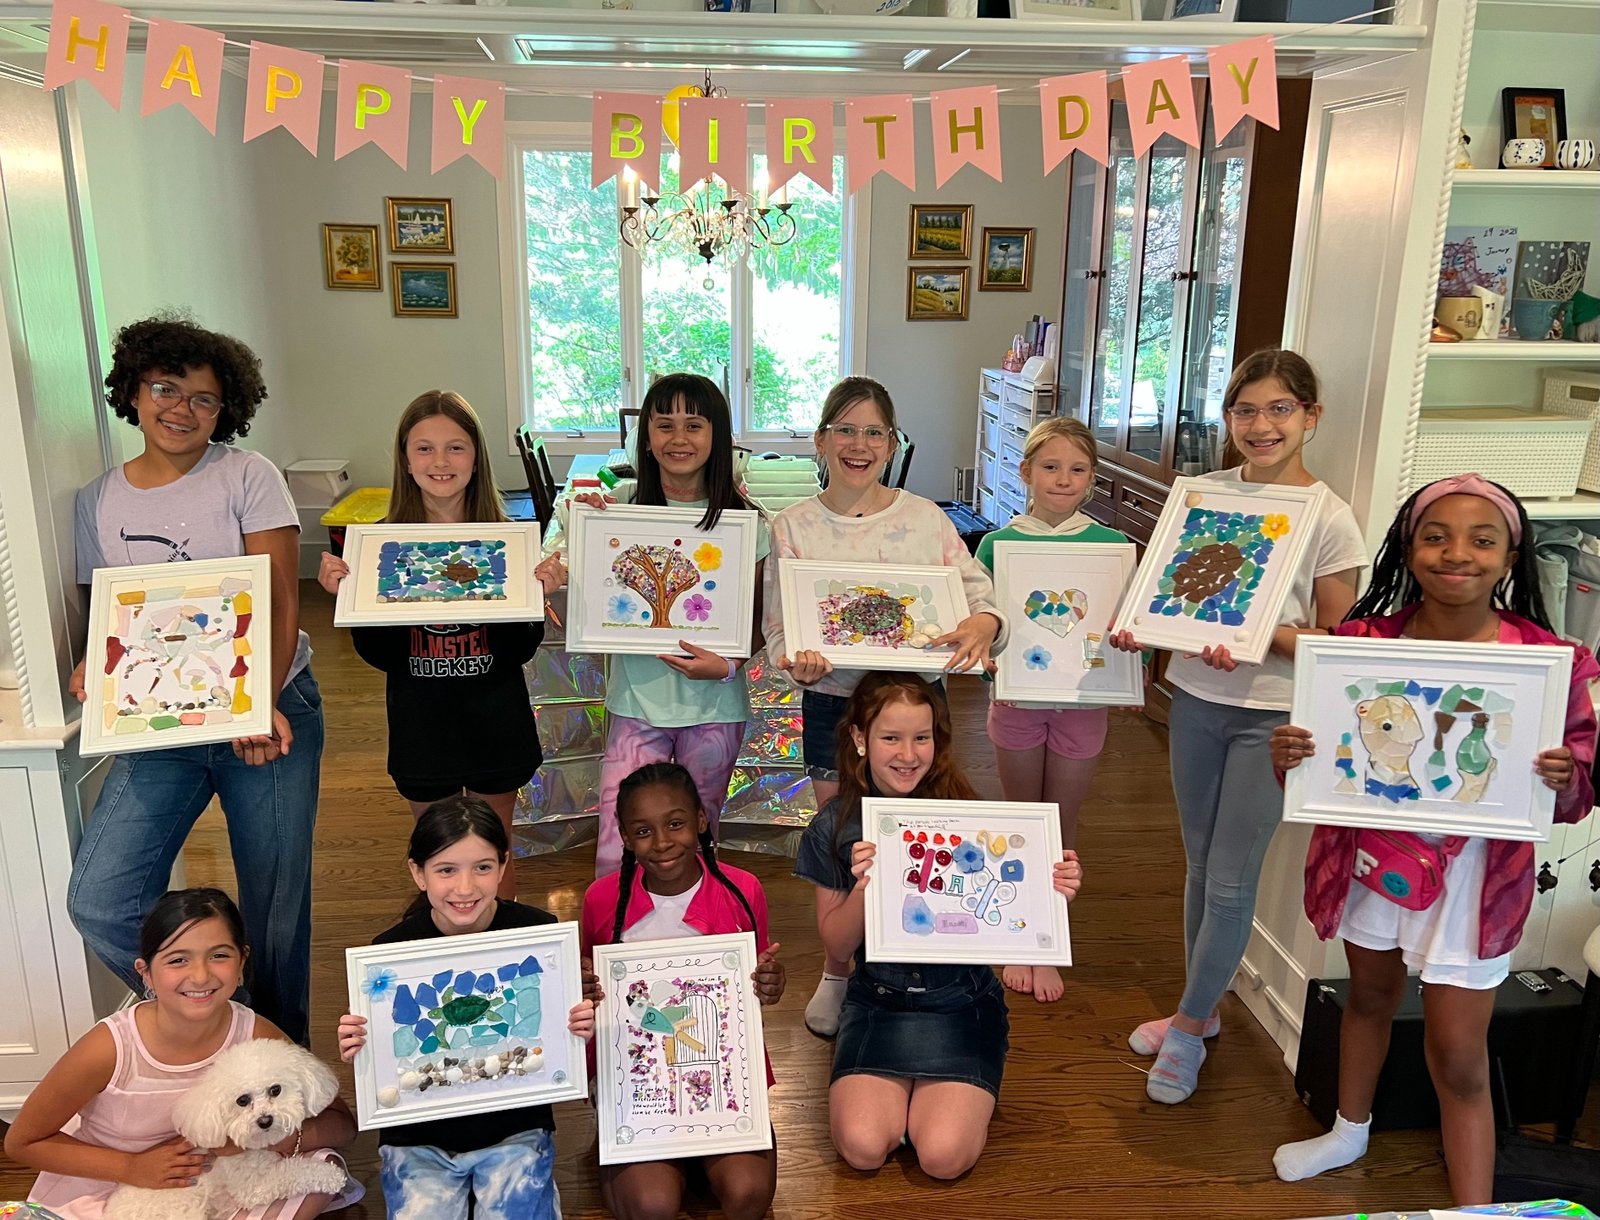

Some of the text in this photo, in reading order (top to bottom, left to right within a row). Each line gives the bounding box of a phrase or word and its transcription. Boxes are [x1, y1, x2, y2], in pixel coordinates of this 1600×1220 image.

[64, 16, 1260, 165] HAPPY BIRTHDAY
[408, 654, 494, 678] HOCKEY
[1353, 847, 1379, 878] F
